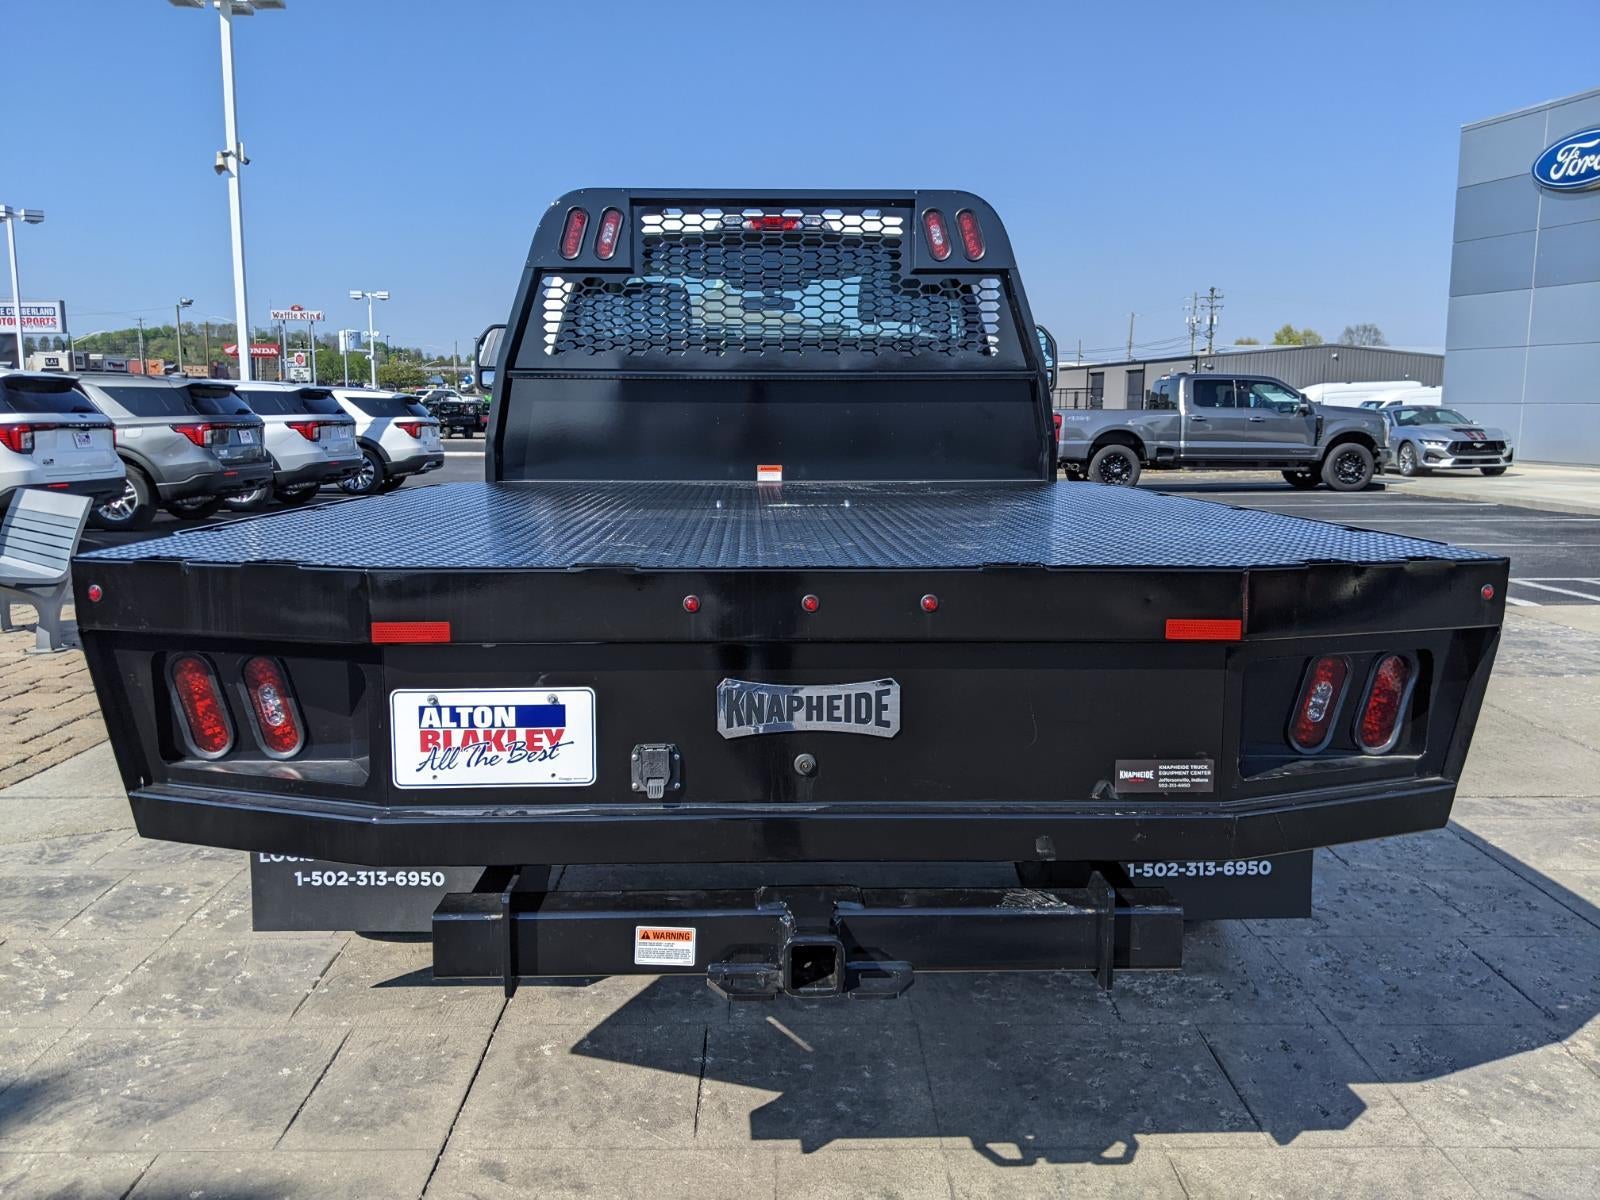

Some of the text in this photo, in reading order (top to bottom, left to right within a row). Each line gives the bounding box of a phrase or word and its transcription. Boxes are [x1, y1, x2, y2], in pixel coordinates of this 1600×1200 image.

[272, 311, 321, 321] Waffle King
[420, 706, 516, 728] ALTON
[726, 688, 891, 729] KNAPHEIDE
[419, 729, 565, 753] BLAKLEY
[416, 740, 574, 772] All The Best
[1119, 769, 1154, 779] KNAPHEIDE
[1127, 860, 1272, 878] 1-502-313-6950
[294, 870, 445, 887] 1-502-313-6950
[652, 931, 690, 941] WARNING
